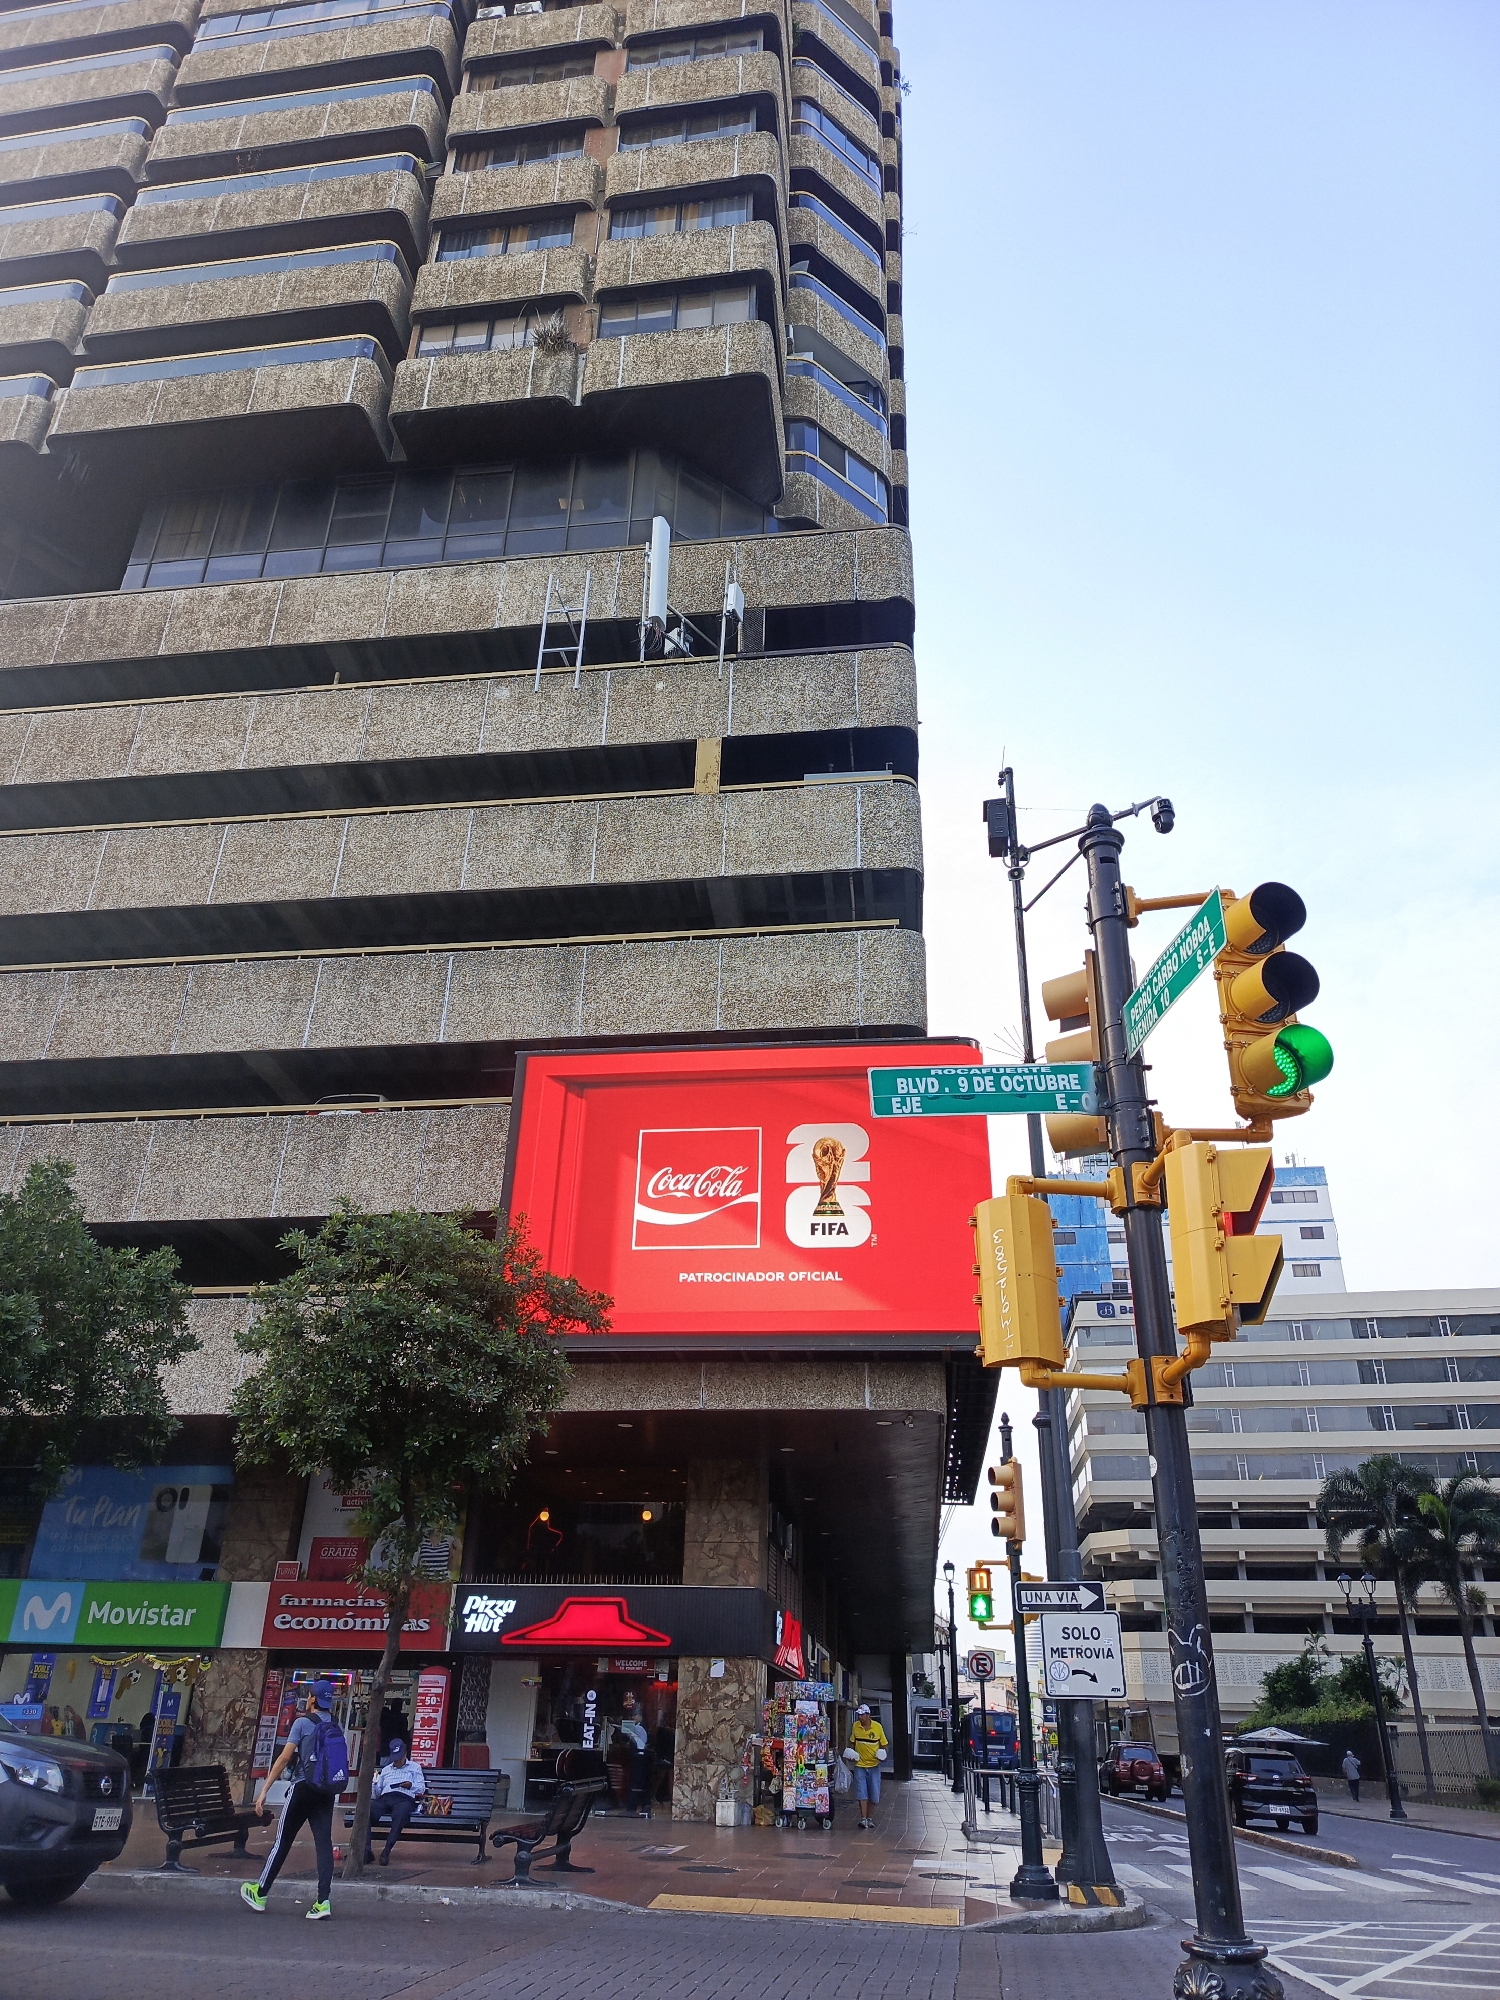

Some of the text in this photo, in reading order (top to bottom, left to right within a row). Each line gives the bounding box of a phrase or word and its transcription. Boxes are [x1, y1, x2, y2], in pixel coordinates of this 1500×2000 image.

[1130, 915, 1211, 1027] PEDRO CARBO NOBOA
[1129, 987, 1170, 1051] AVENIDA 10
[930, 1067, 1052, 1075] ROCAFUERTE
[957, 1076, 969, 1092] 9
[973, 1075, 996, 1092] DE
[1000, 1074, 1081, 1092] OCTUBRE
[891, 1097, 923, 1114] EJE
[647, 1165, 749, 1198] Coca-Cola
[810, 1222, 849, 1236] FIFA
[679, 1271, 843, 1283] PATROCINADOR OFICIAL
[63, 1495, 87, 1525] Tu
[91, 1494, 142, 1528] Plan
[320, 1547, 359, 1557] GRATIS
[278, 1567, 297, 1576] TURNO
[279, 1593, 387, 1607] farmacias
[1025, 1591, 1079, 1603] UNA VIA
[87, 1601, 197, 1626] Movistar
[462, 1595, 517, 1618] Pizza
[273, 1611, 430, 1631] económias
[464, 1613, 504, 1633] Hut
[1061, 1626, 1101, 1640] SOLO
[1050, 1647, 1115, 1659] METROVIA
[582, 1703, 597, 1749] EAT-IN
